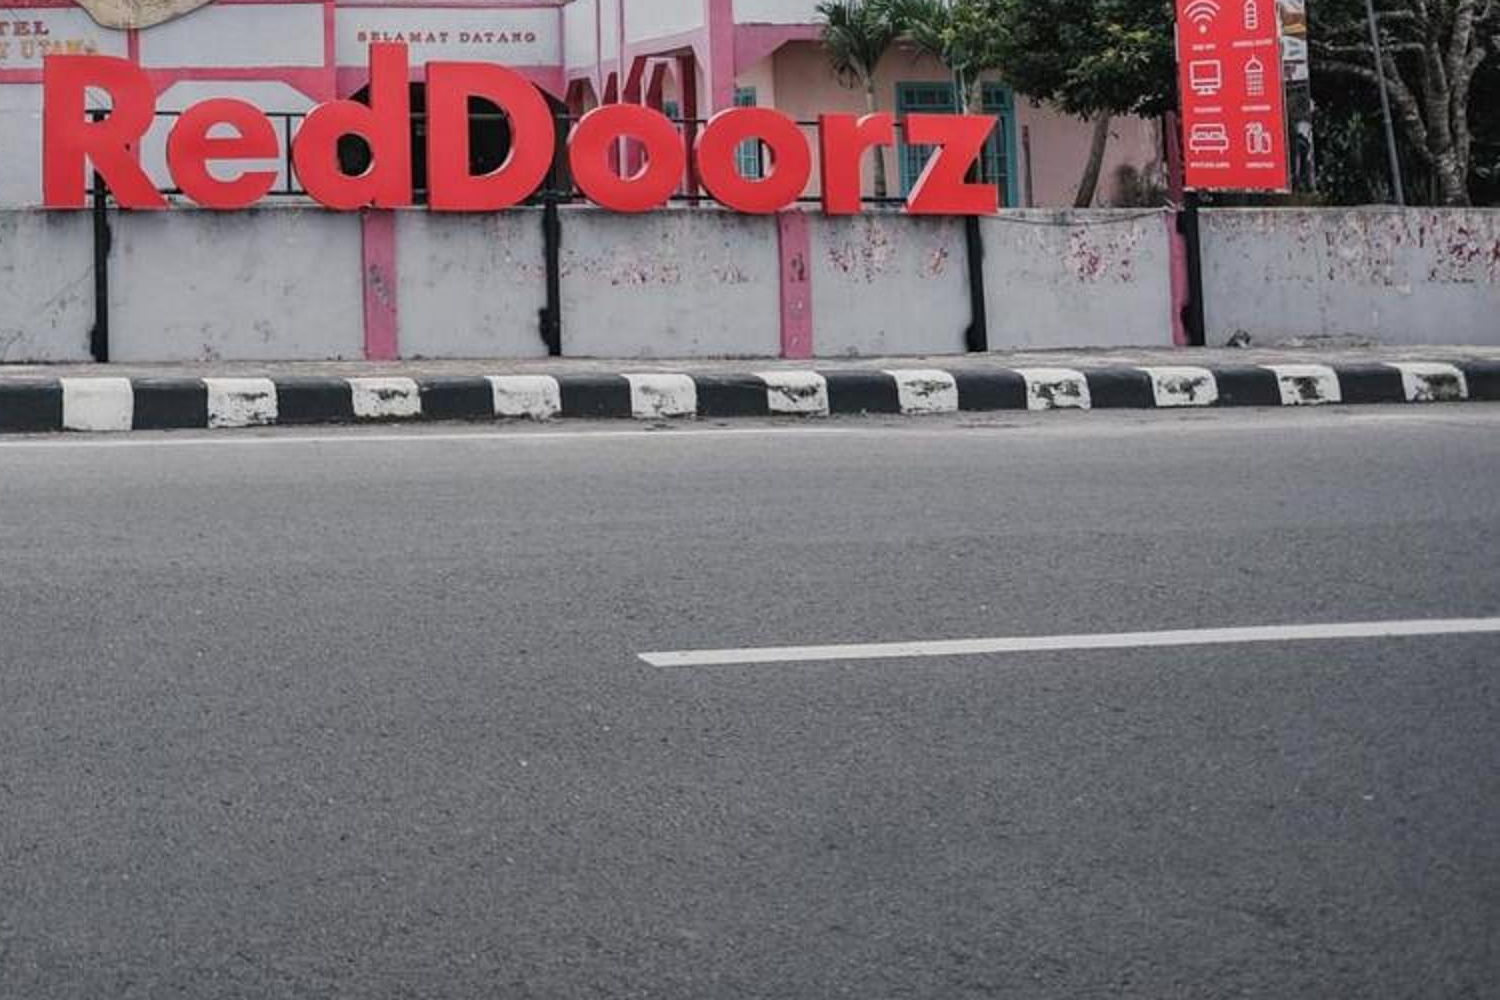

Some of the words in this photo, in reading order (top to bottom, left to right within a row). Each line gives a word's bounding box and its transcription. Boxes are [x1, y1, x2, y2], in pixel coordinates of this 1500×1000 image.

[357, 31, 450, 43] SELAMAT
[459, 31, 537, 43] DATANG
[43, 42, 999, 216] RedDoorz
